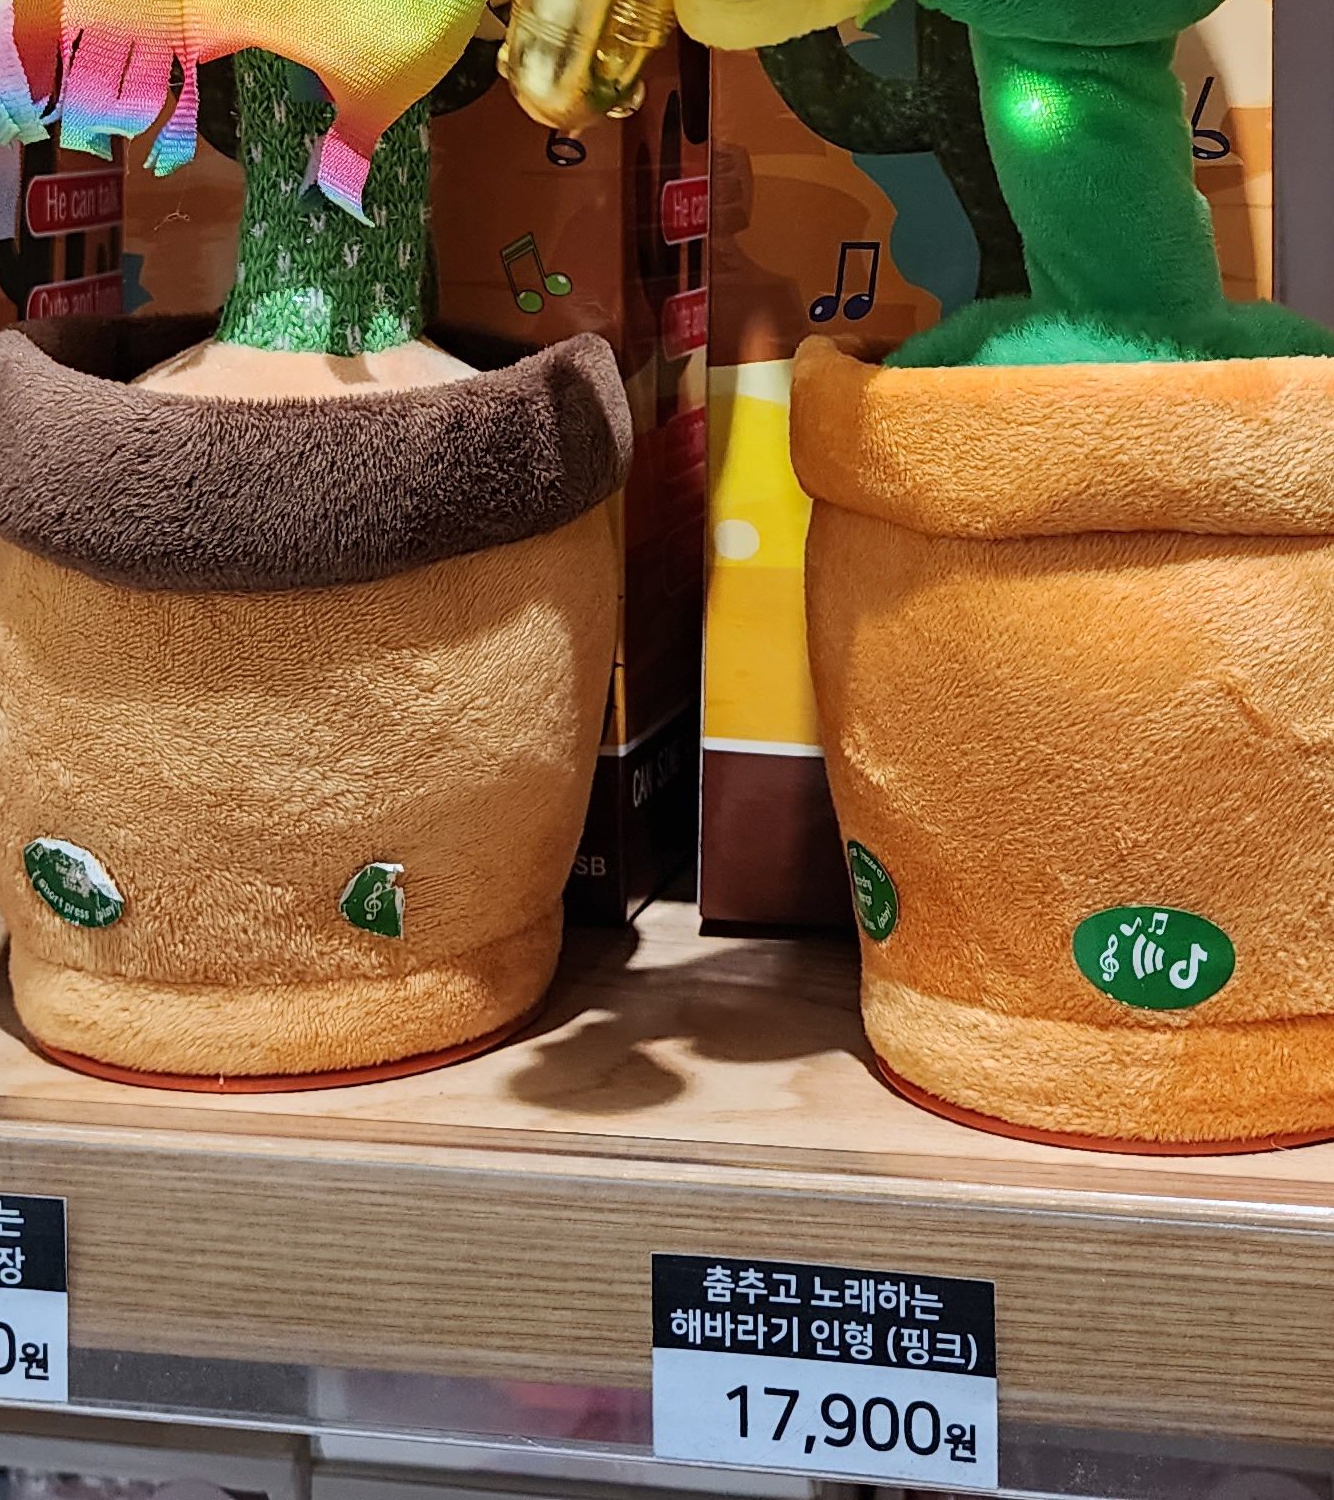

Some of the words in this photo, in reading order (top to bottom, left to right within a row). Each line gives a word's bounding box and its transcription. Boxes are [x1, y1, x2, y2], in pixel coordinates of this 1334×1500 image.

[46, 183, 67, 222] He
[71, 188, 95, 219] can
[692, 194, 708, 226] ca
[573, 855, 607, 877] SB
[702, 1265, 801, 1305] 춤추고
[810, 1276, 944, 1322] 노래하는
[669, 1308, 799, 1353] 해바라기
[810, 1319, 873, 1360] 인형
[886, 1325, 978, 1371] (핑크)
[726, 1385, 977, 1463] 17,900원
